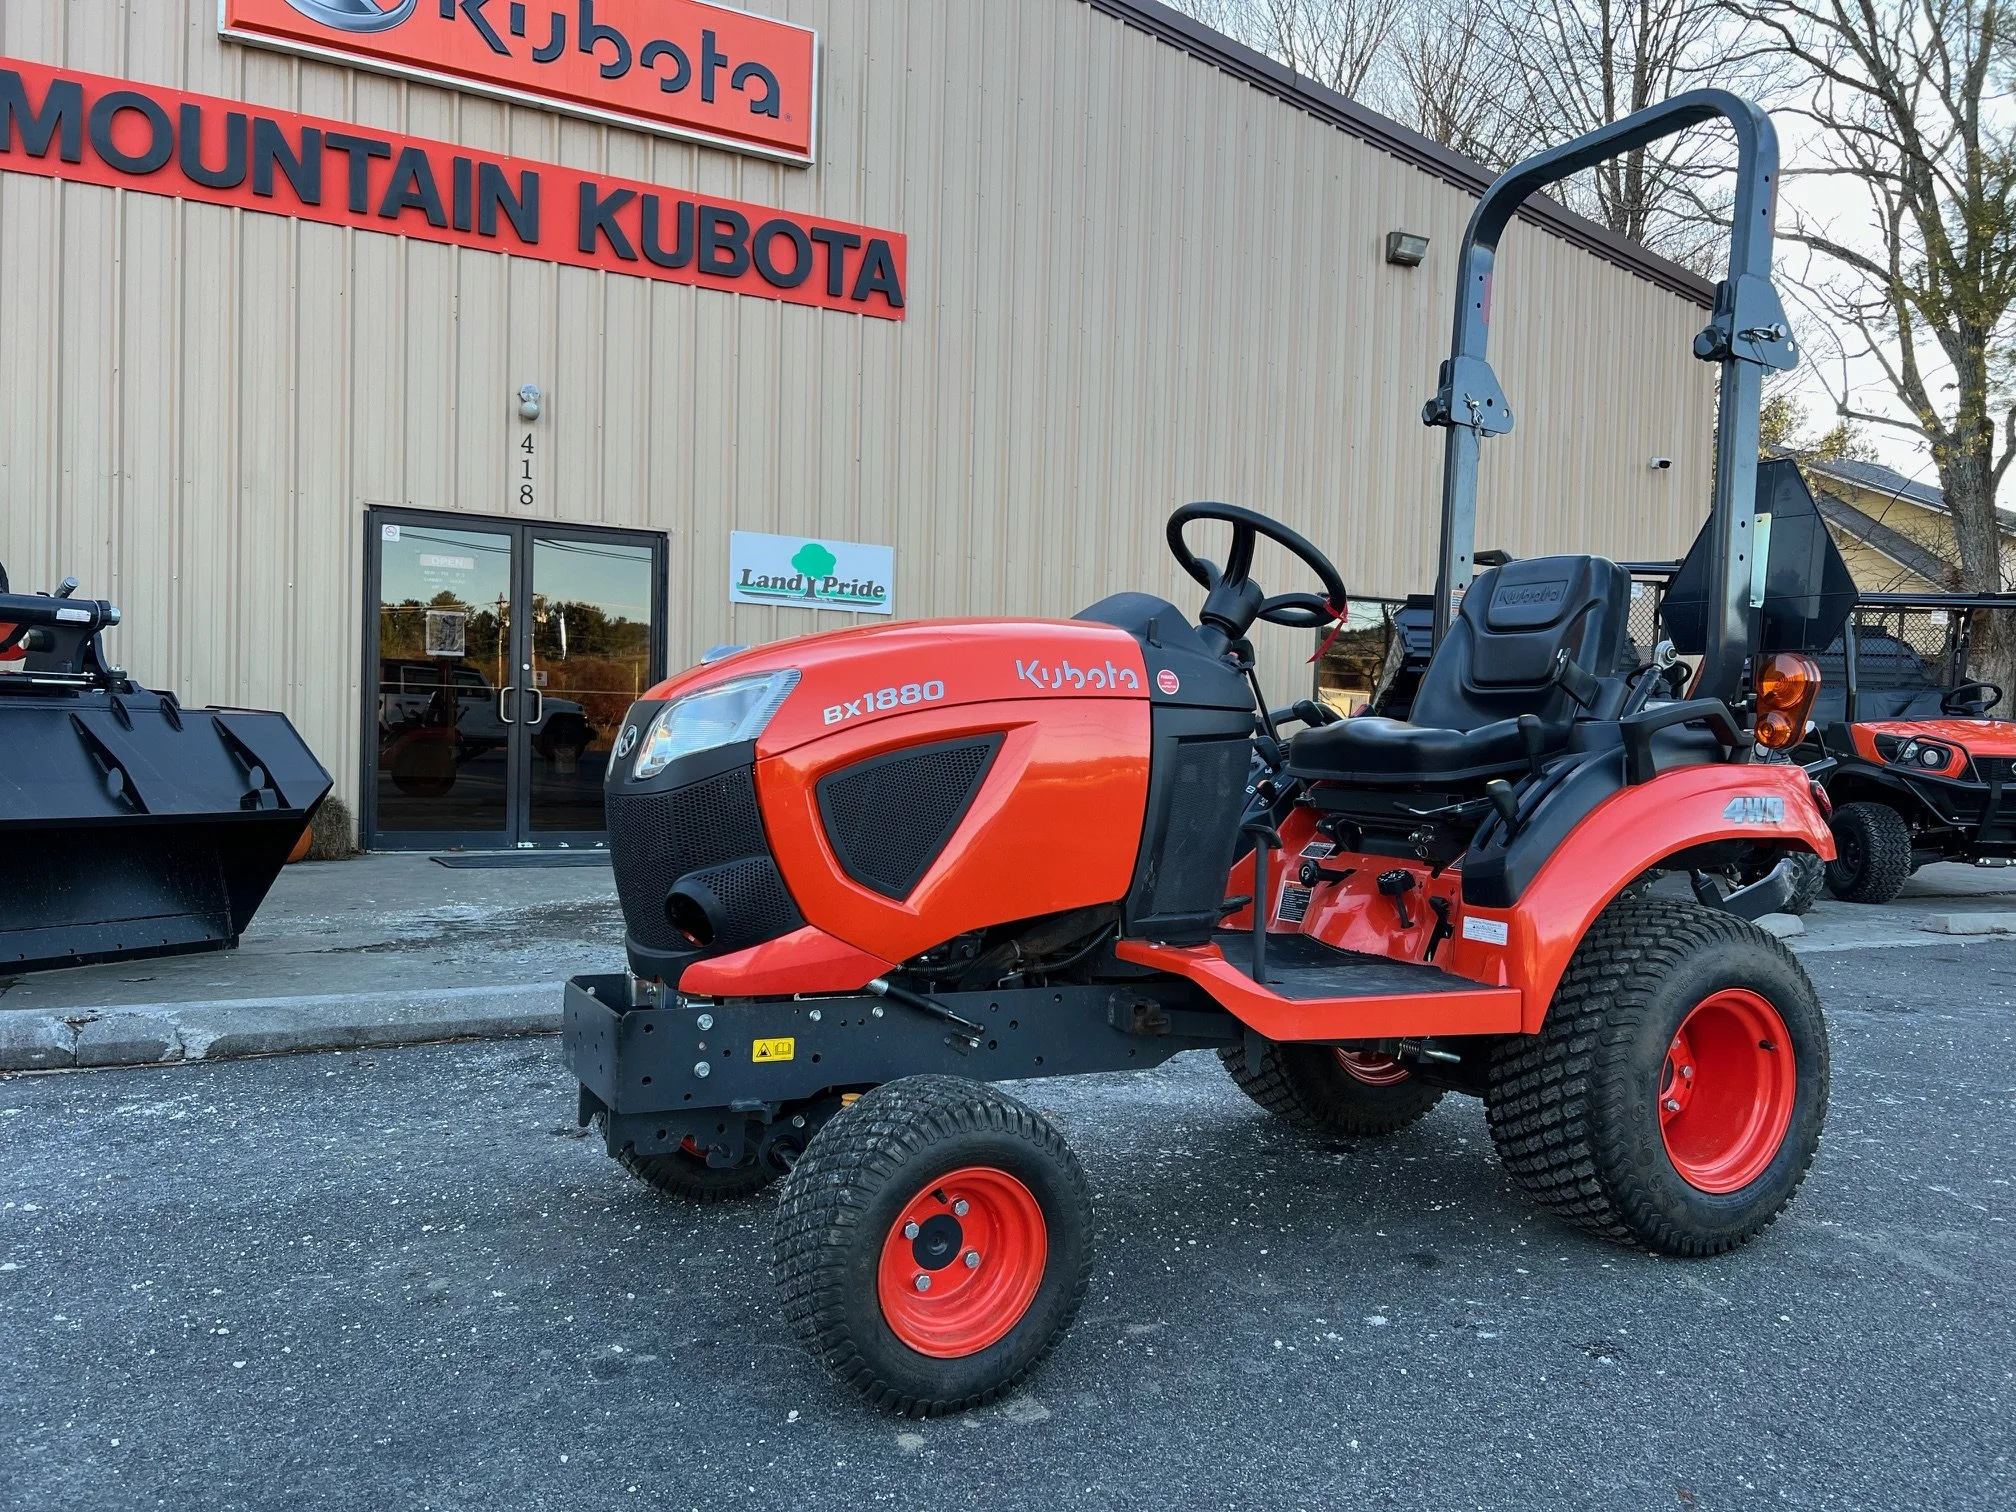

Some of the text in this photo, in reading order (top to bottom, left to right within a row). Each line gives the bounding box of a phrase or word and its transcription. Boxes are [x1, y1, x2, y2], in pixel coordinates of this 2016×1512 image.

[439, 0, 780, 118] Kubota
[0, 69, 905, 308] MOUNTAIN KUBOTA
[520, 433, 534, 505] 418
[431, 556, 465, 567] OPEN
[740, 568, 885, 598] Land Pride
[1499, 586, 1559, 605] Kubota
[1015, 660, 1139, 689] Kubota
[823, 680, 944, 726] BX1880
[1723, 797, 1785, 823] 4WD
